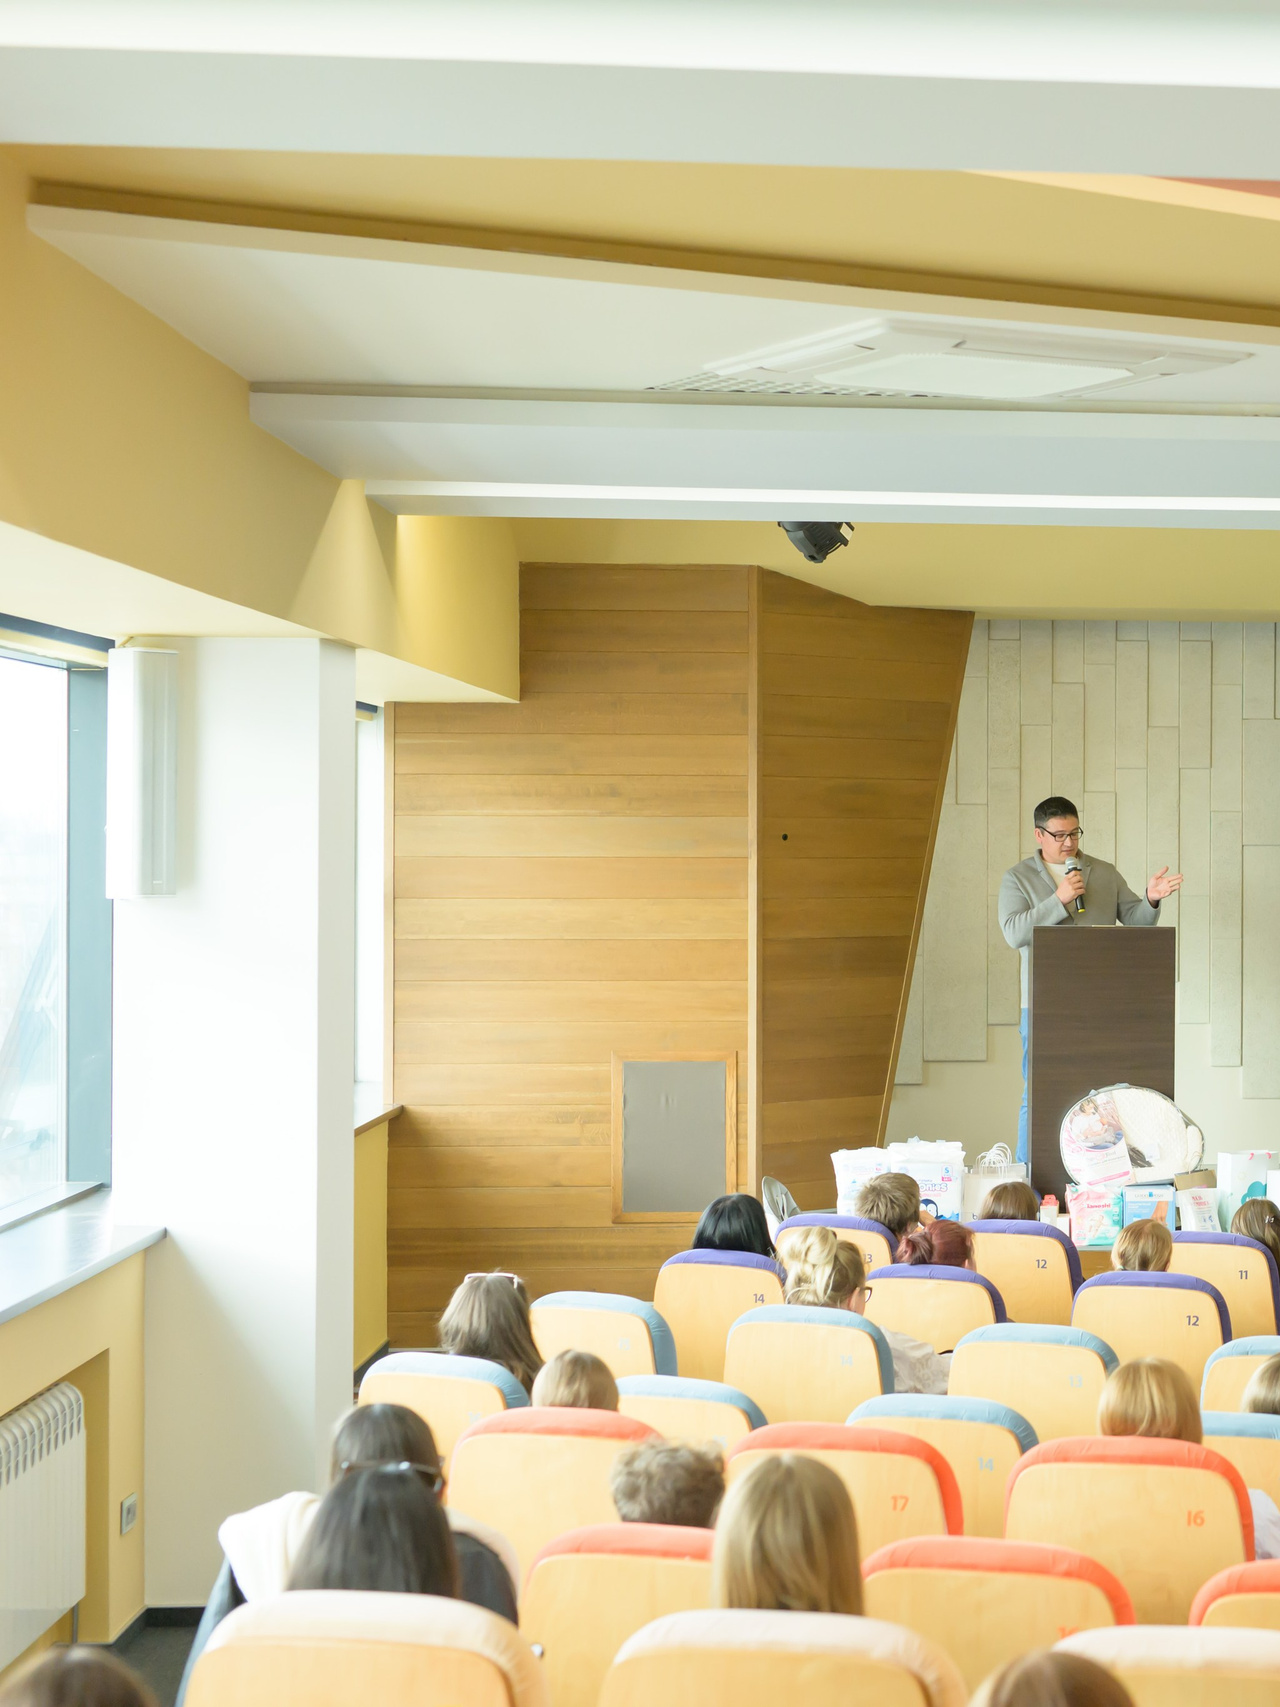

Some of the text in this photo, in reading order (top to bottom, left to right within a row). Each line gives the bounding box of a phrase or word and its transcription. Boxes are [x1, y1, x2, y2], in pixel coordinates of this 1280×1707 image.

[1035, 1259, 1047, 1269] 12
[1238, 1270, 1248, 1280] 11
[753, 1293, 765, 1304] 14
[1186, 1315, 1199, 1327] 12
[977, 1457, 994, 1472] 14
[890, 1495, 909, 1512] 17
[1186, 1510, 1206, 1527] 16
